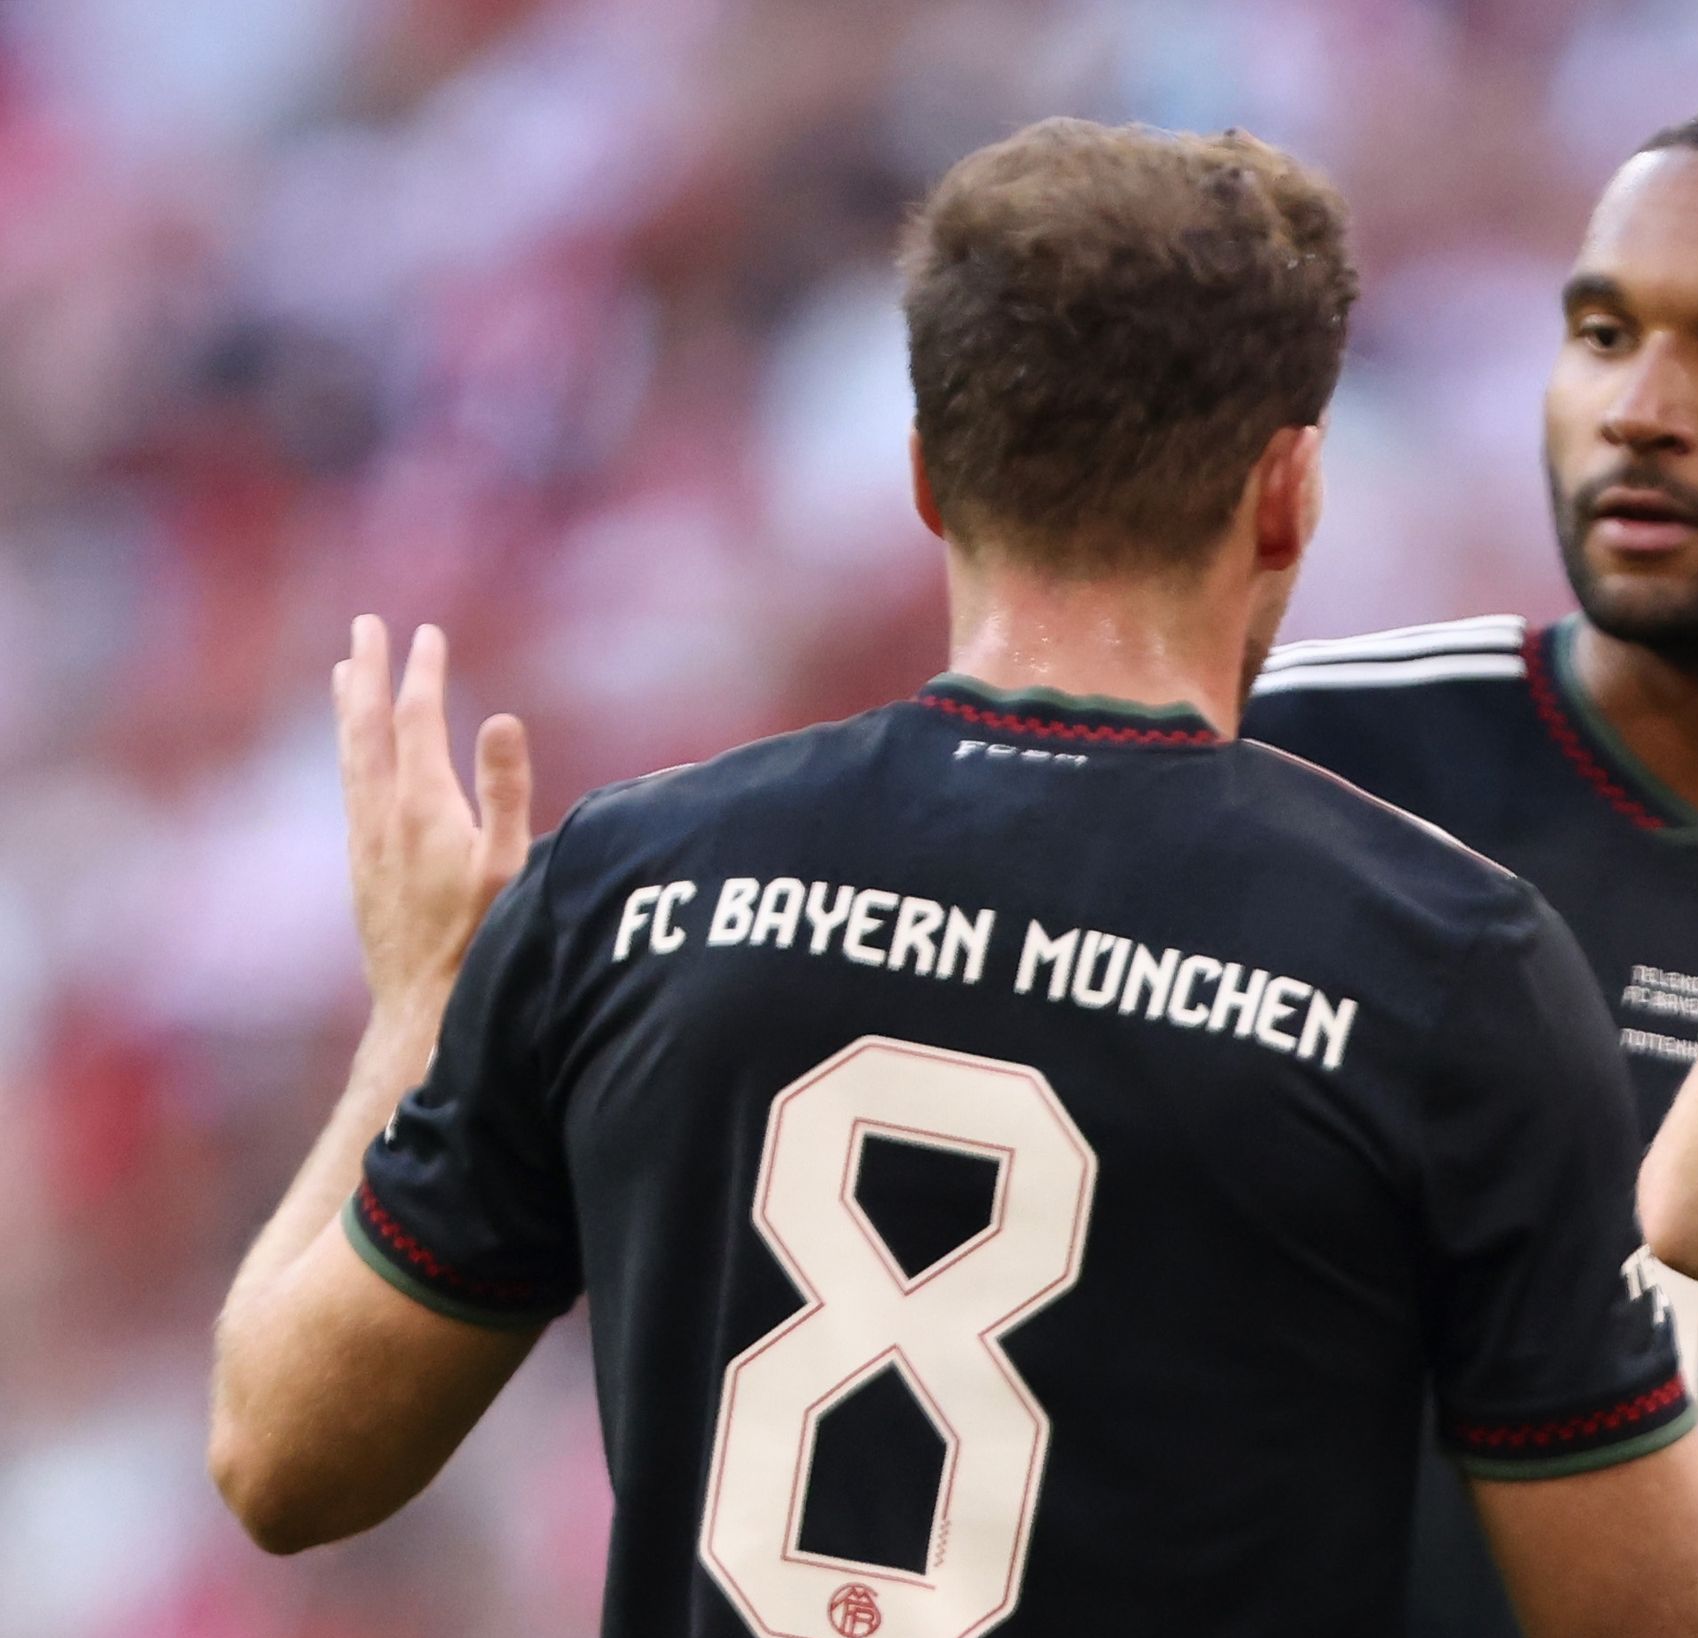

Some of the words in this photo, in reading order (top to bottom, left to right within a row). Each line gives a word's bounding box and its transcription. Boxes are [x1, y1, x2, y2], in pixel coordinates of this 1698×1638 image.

[612, 879, 698, 962] FC
[706, 876, 996, 985] BAYERN
[1013, 918, 1358, 1071] MÜNCHEN
